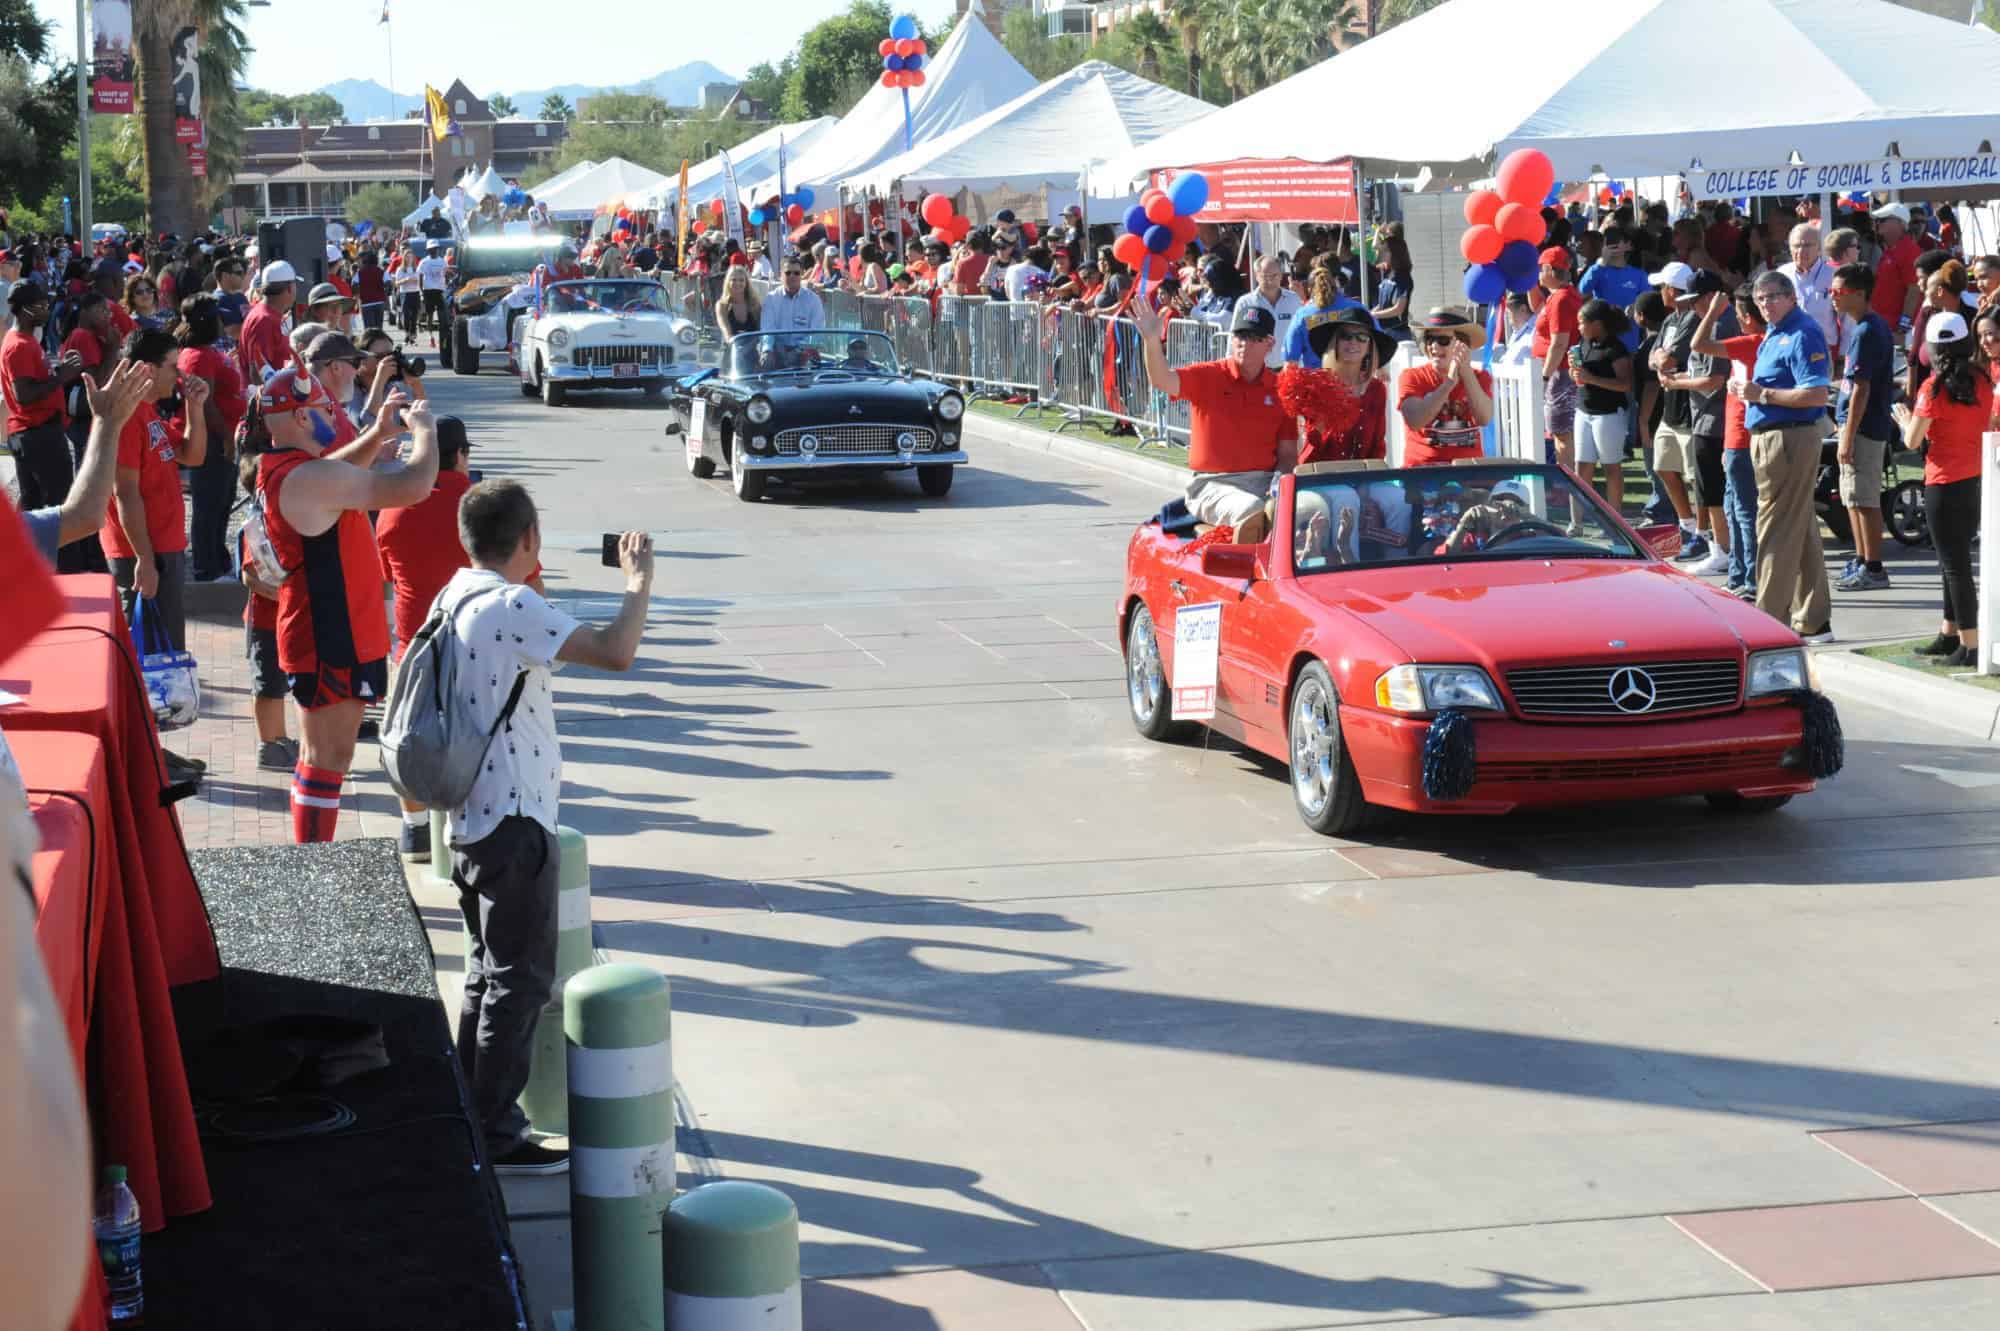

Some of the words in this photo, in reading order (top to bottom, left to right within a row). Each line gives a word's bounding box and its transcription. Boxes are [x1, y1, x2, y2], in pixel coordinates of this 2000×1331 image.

[1706, 169, 1778, 193] COLLEGE
[1787, 167, 1809, 189] OF
[1817, 163, 1873, 187] SOCIAL
[1881, 166, 1892, 185] &
[1900, 156, 1999, 183] BEHAVIORAL
